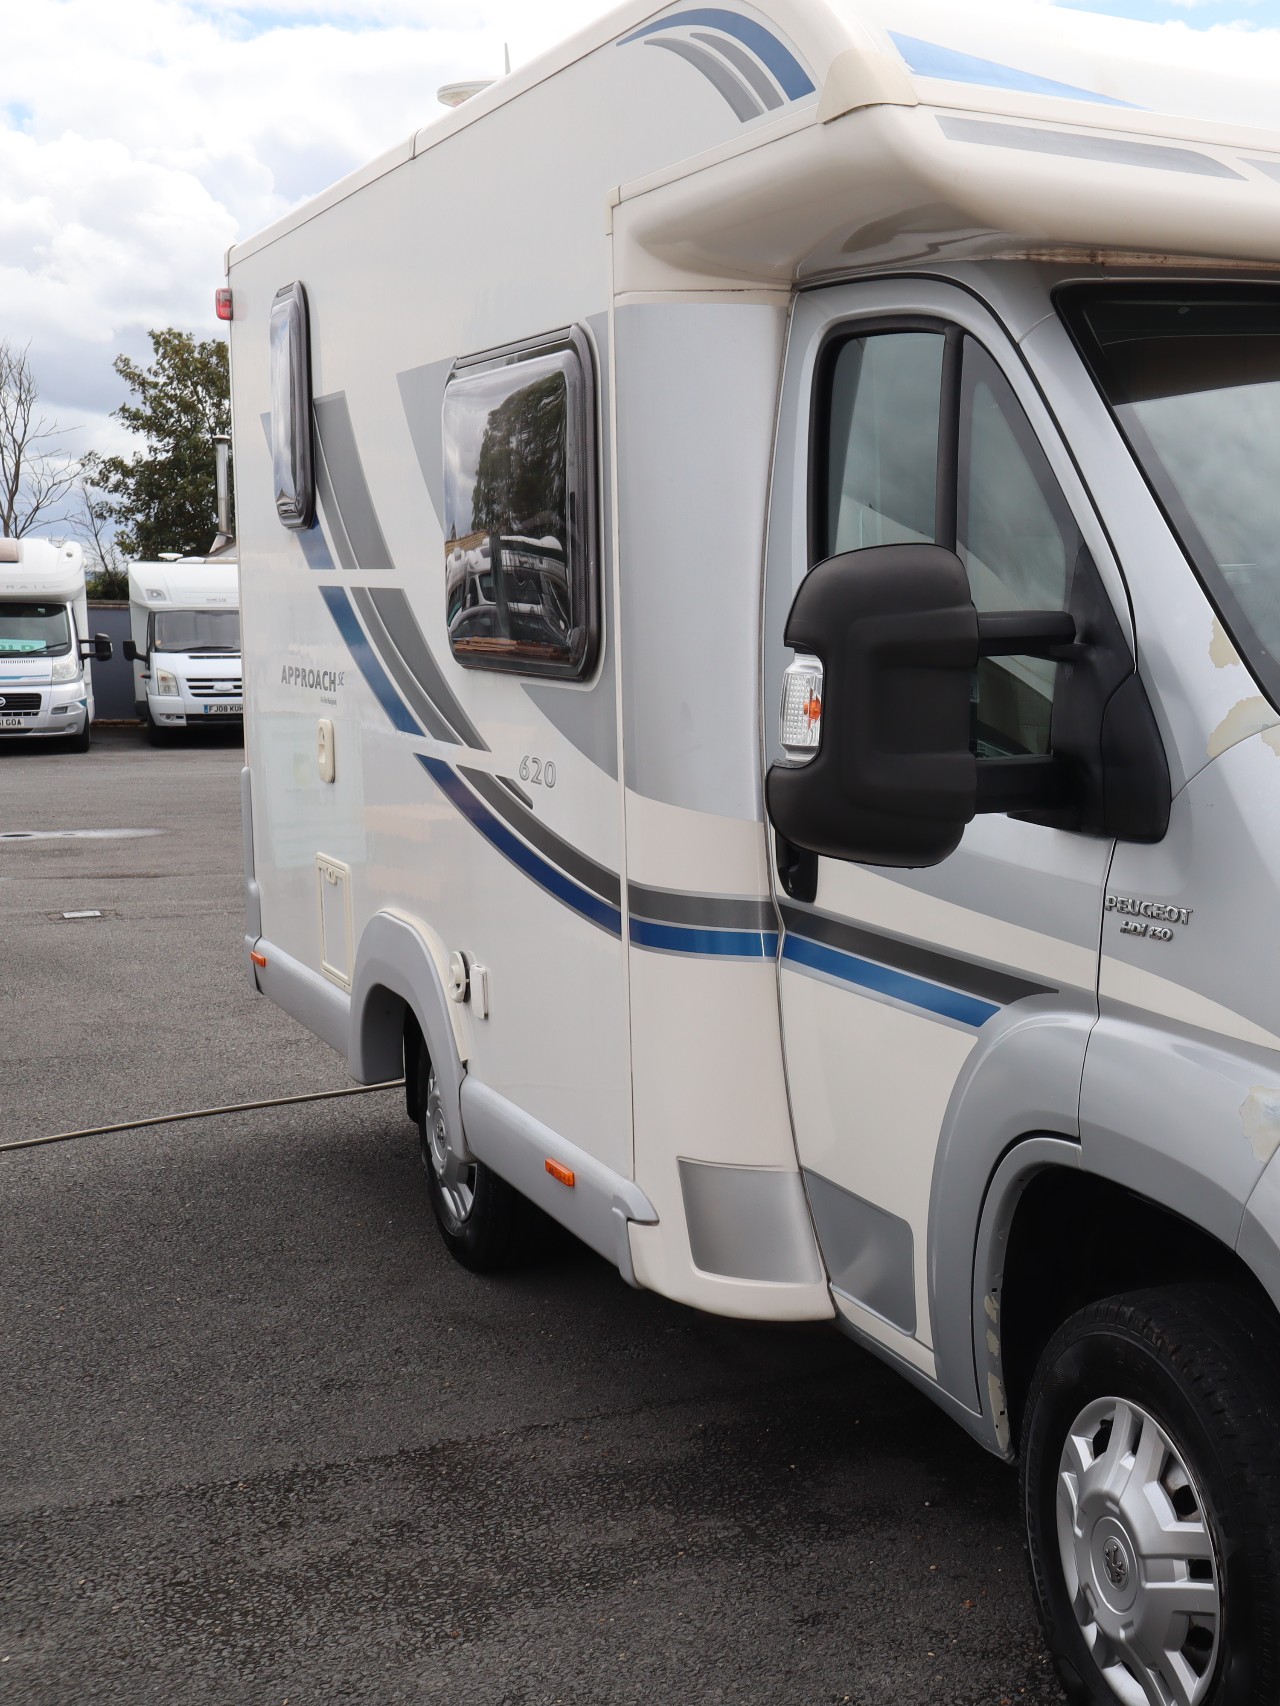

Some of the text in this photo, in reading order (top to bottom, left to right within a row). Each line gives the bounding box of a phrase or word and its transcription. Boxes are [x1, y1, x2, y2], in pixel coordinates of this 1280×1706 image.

[280, 664, 337, 692] APPROACH
[518, 755, 558, 789] 620
[1105, 895, 1194, 925] PEUGEOT
